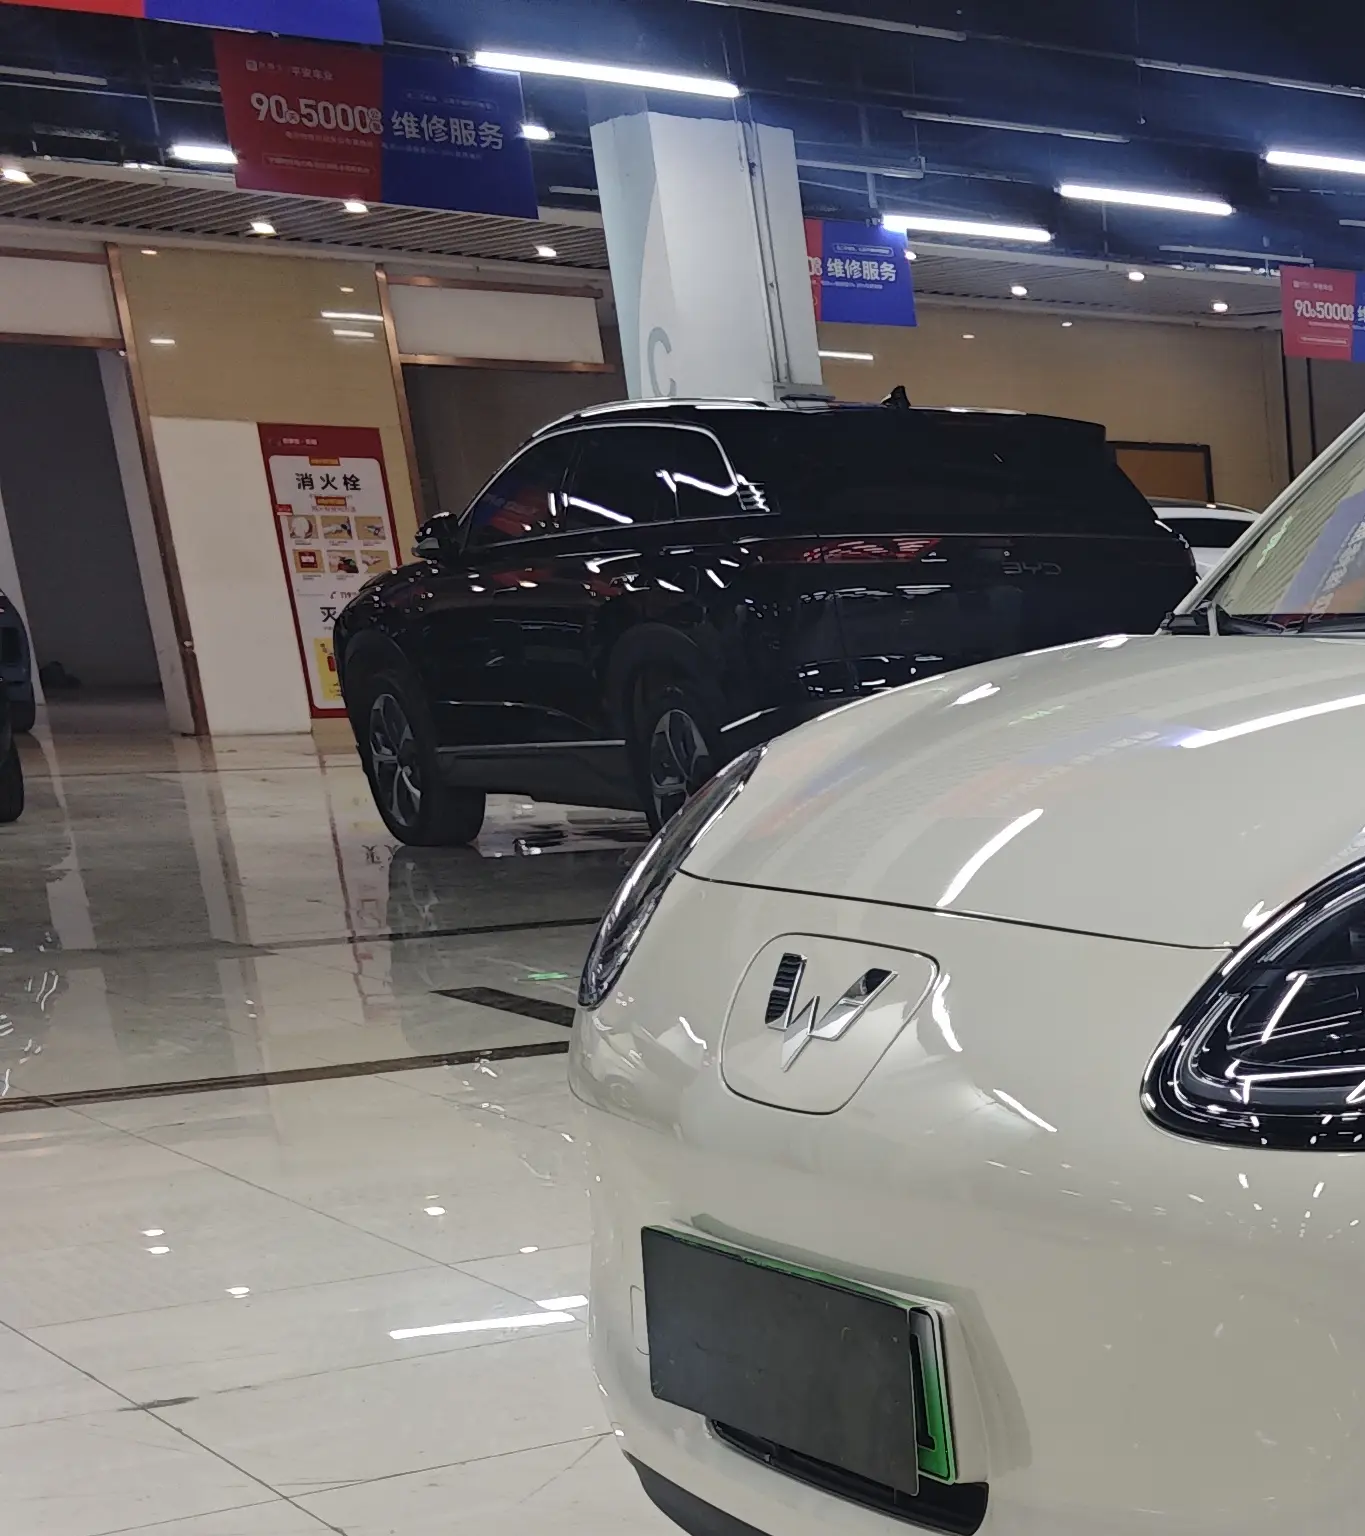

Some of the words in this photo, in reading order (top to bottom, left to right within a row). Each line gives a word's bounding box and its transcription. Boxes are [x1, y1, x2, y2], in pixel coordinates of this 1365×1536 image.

[391, 110, 504, 150] 维修服务
[827, 257, 896, 282] 维修服务
[295, 473, 361, 491] 消火栓
